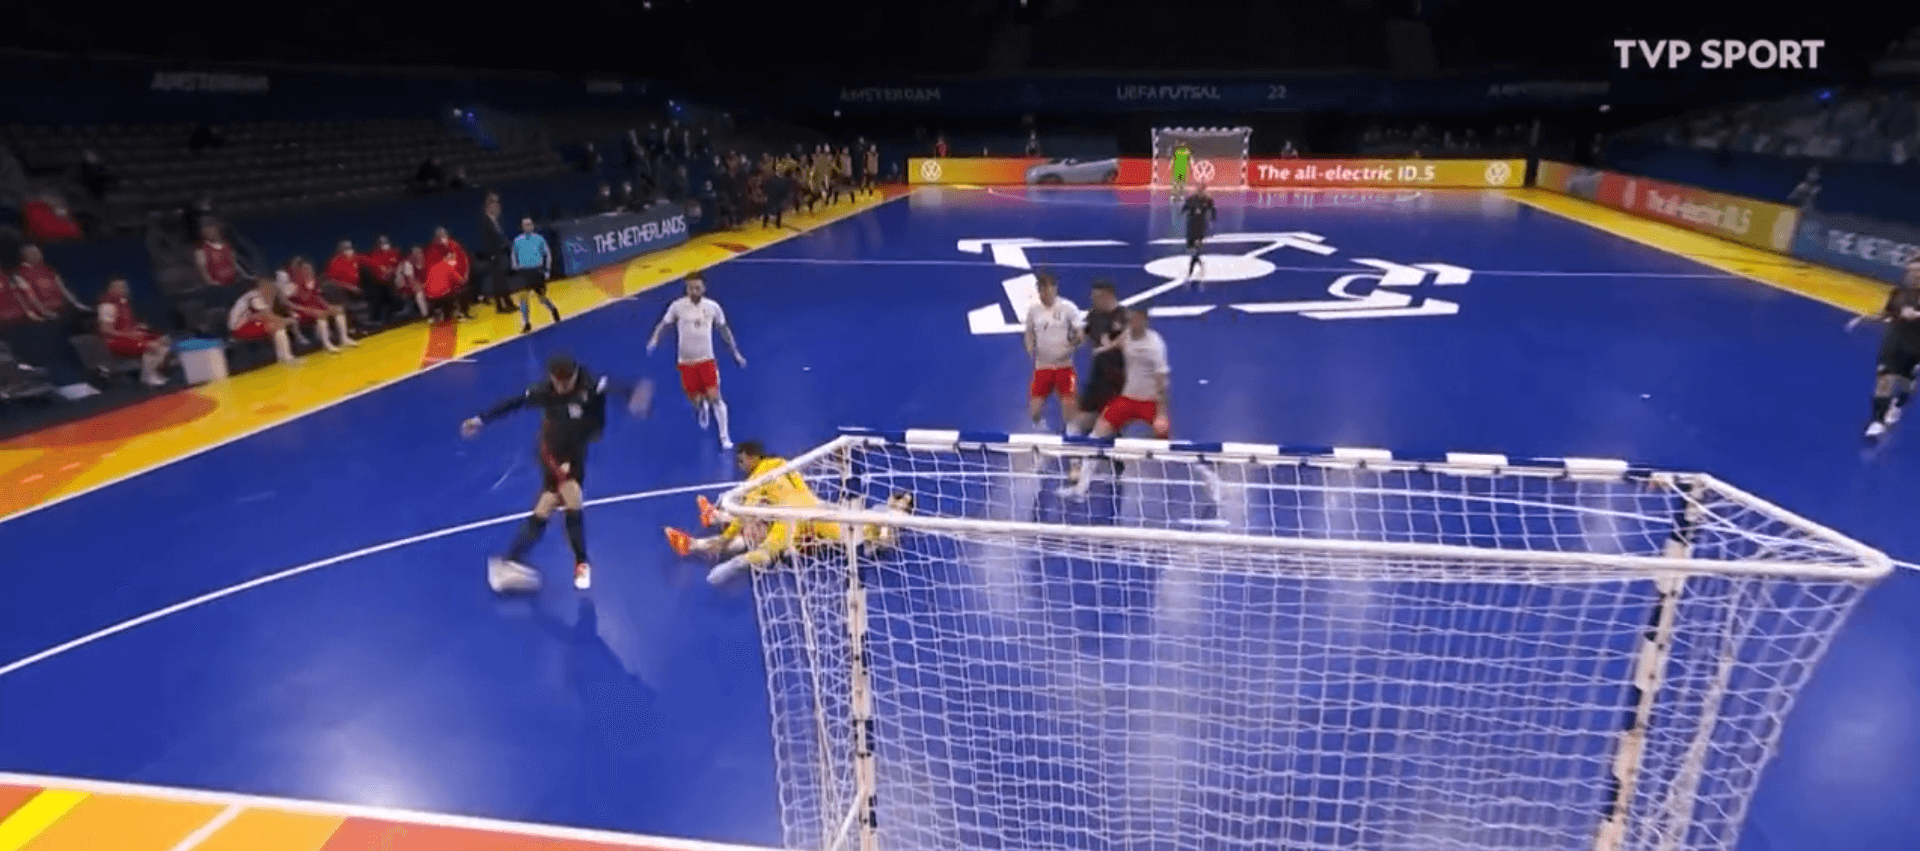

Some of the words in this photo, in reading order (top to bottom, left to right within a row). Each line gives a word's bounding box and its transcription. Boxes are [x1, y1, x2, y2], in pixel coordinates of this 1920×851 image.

[1116, 85, 1157, 101] UEFA
[1158, 85, 1221, 101] FUTSAL
[1257, 164, 1291, 181] The
[1295, 164, 1393, 182] all-electric
[593, 231, 617, 254] THE
[618, 214, 687, 249] NETHERLANDS
